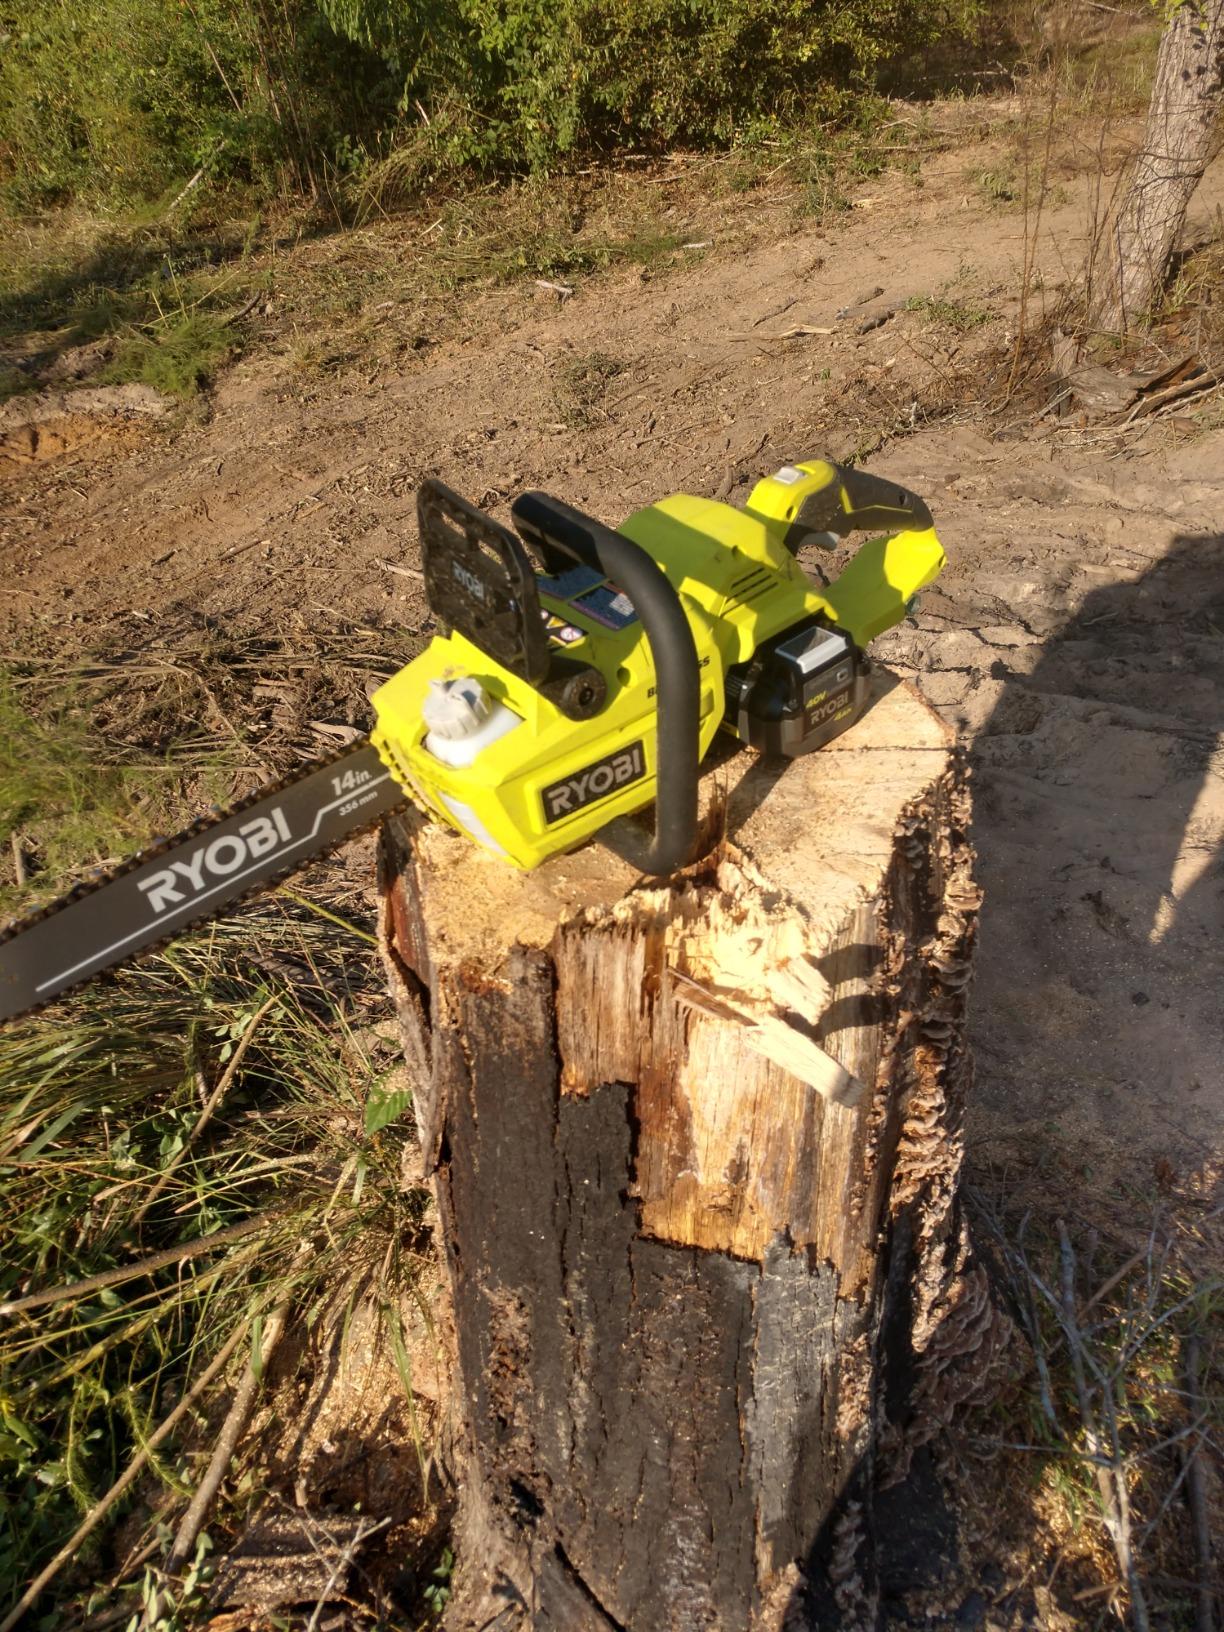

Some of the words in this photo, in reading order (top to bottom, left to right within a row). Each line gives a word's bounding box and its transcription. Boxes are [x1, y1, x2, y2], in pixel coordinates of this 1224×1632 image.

[452, 560, 484, 600] RYOBI
[810, 691, 849, 724] RYOBI
[547, 748, 641, 816] RYOBI
[339, 800, 359, 816] 356
[359, 791, 378, 806] mm
[137, 807, 292, 914] RYOBI
